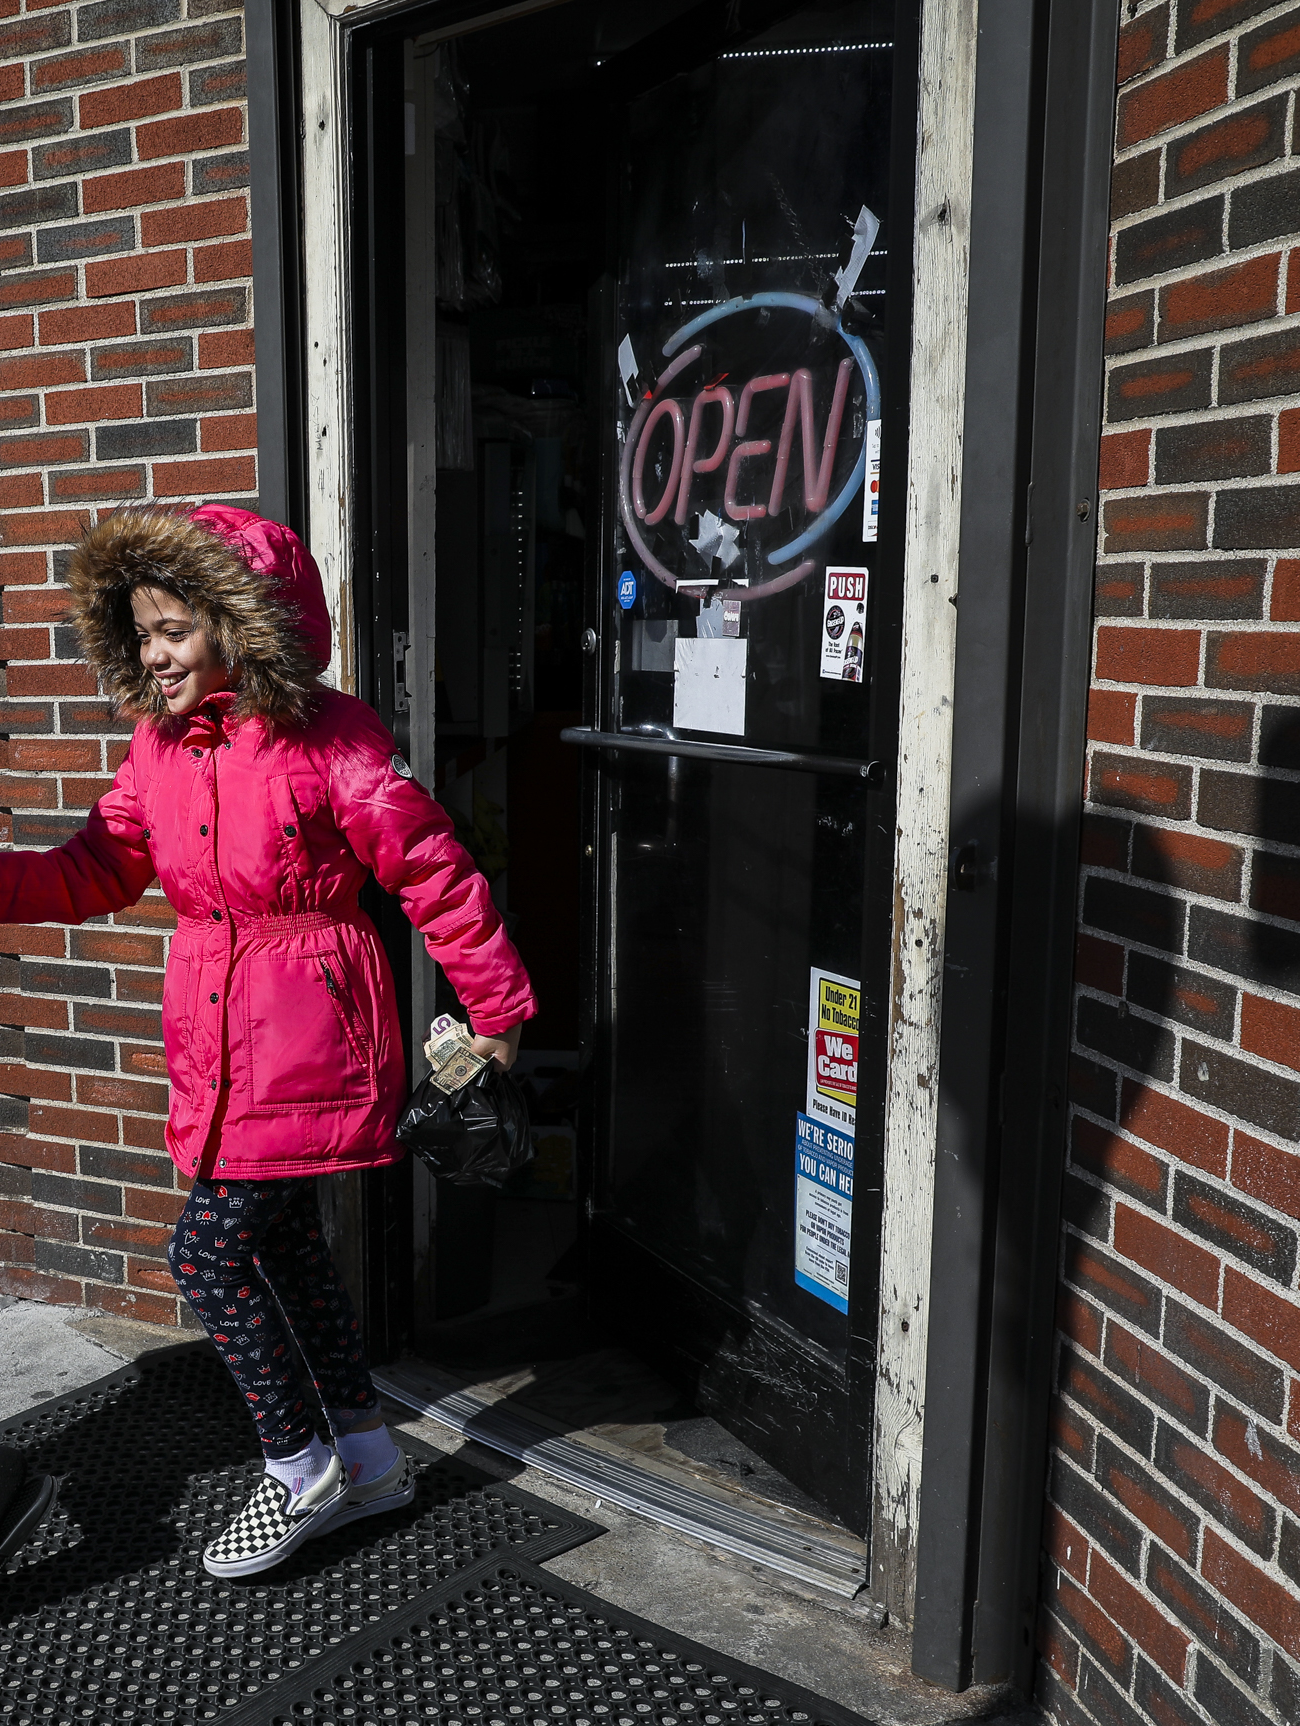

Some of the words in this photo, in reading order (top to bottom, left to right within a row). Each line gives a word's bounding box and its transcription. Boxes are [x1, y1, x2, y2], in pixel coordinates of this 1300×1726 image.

[632, 357, 852, 526] OPEN
[620, 581, 634, 596] ADT
[829, 576, 864, 598] PUSH
[825, 985, 847, 1006] Under
[848, 993, 857, 1010] 21
[821, 1003, 831, 1021] No
[432, 1016, 451, 1036] 5
[824, 1034, 854, 1061] We
[817, 1054, 858, 1083] Card
[812, 1098, 828, 1114] Please
[830, 1104, 841, 1120] Have
[842, 1110, 847, 1122] ID
[798, 1118, 825, 1147] WE'RE
[826, 1132, 854, 1161] SERIO
[799, 1152, 817, 1177] YOU
[819, 1163, 837, 1188] CAN
[195, 1196, 210, 1205] LOVE
[198, 1249, 217, 1261] LOVE
